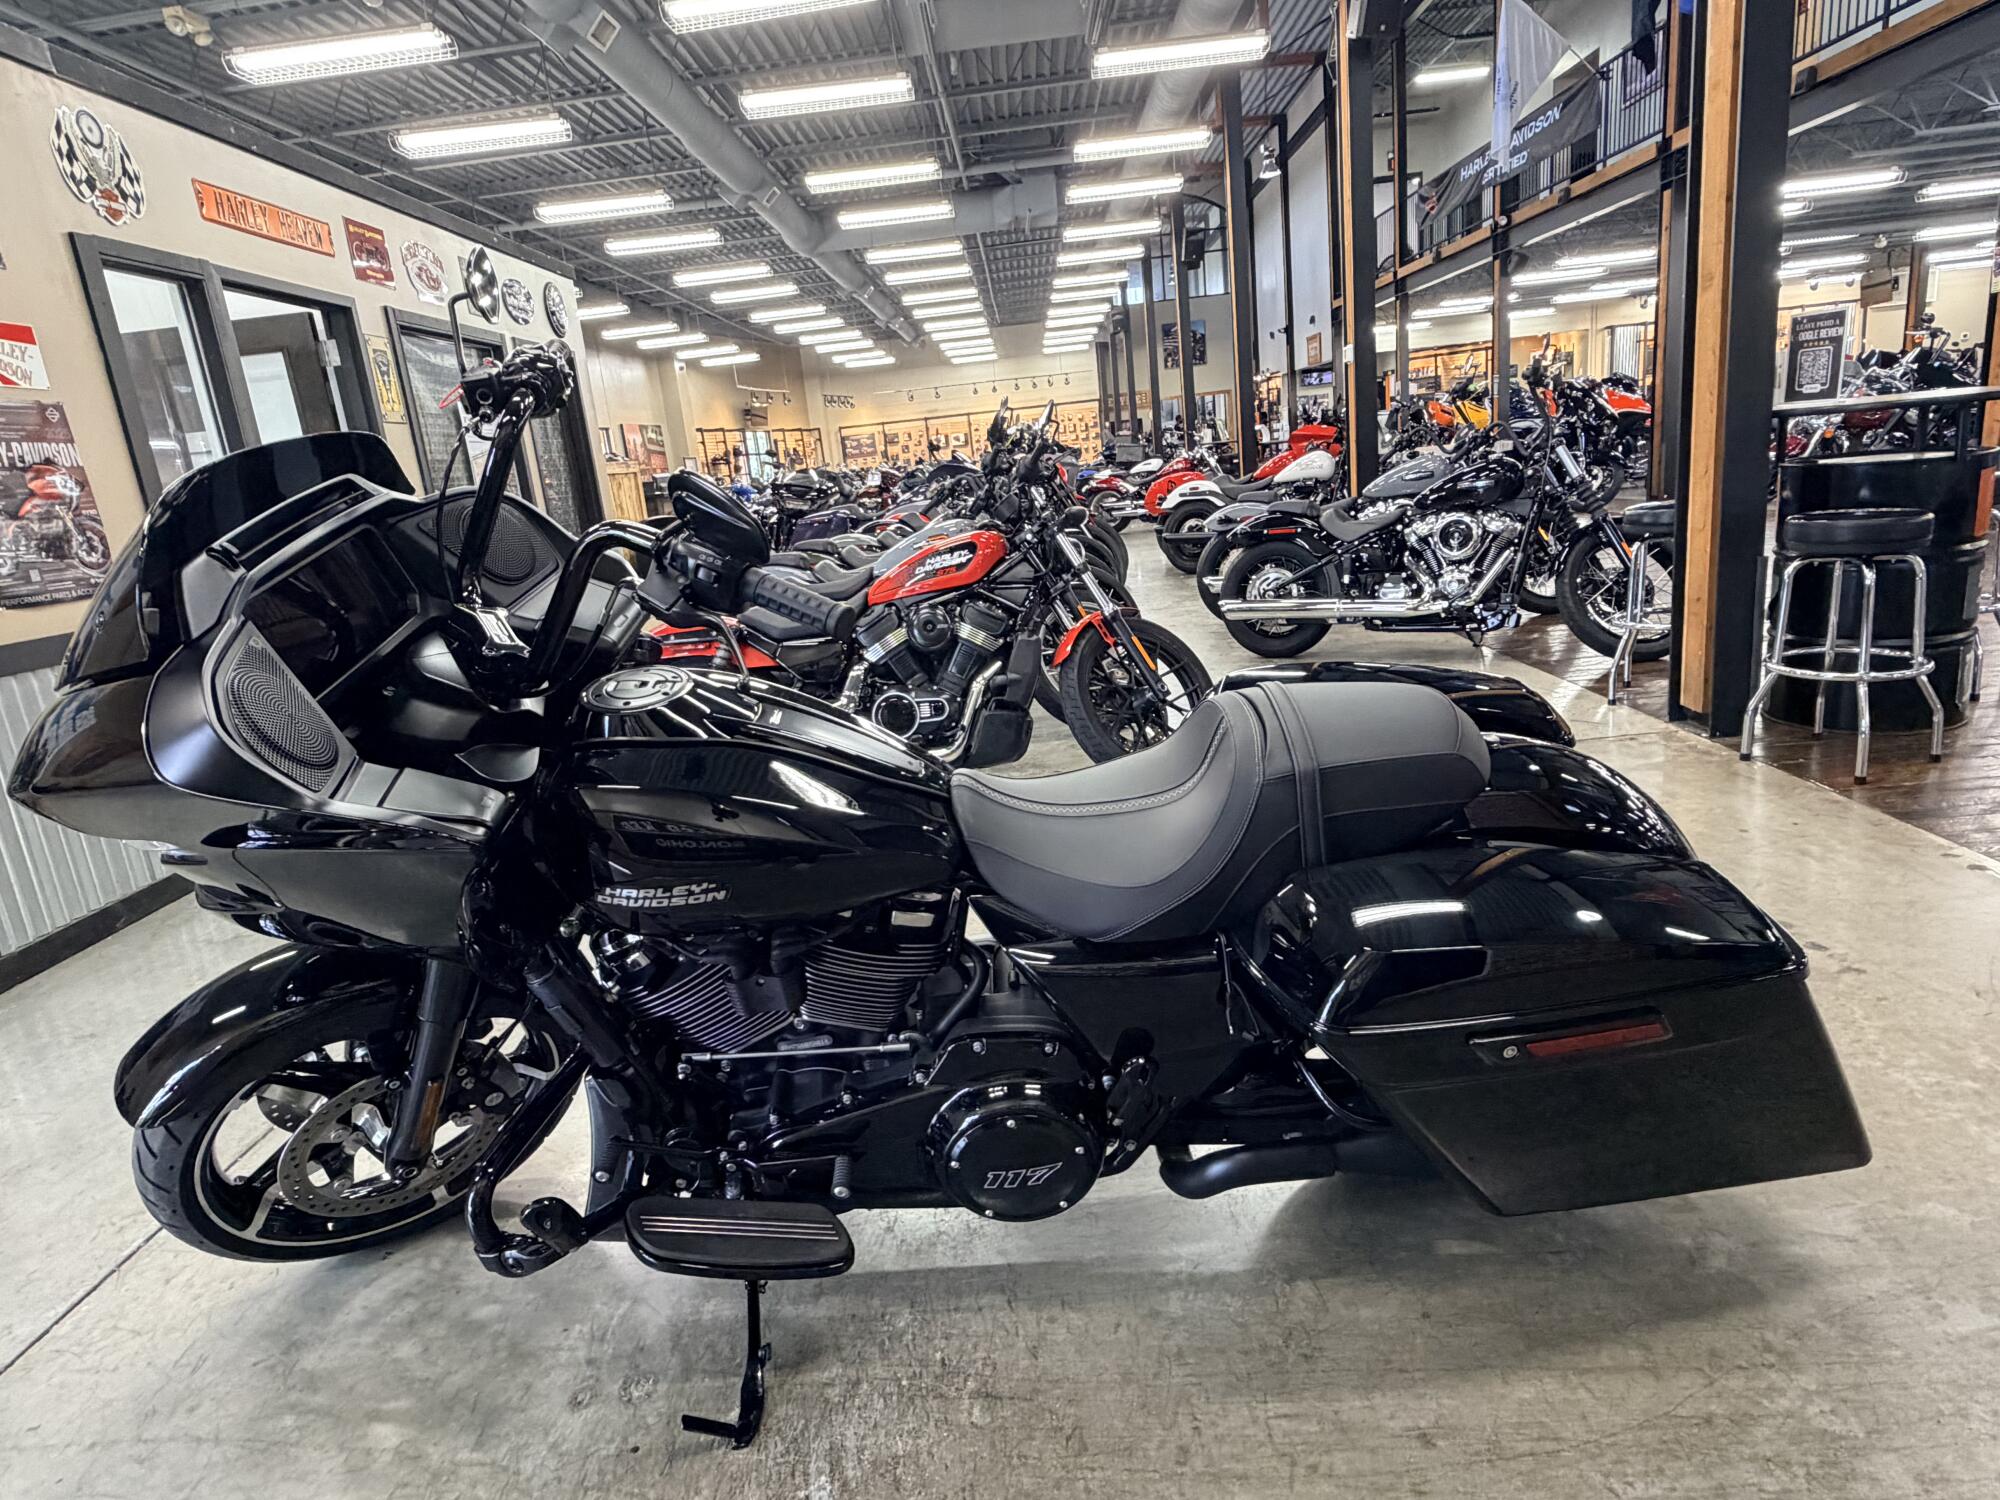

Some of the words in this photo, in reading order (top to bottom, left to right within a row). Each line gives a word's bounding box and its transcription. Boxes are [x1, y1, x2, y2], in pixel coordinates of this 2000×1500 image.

[213, 189, 271, 233] HARLEY
[277, 210, 324, 249] HEAVEN
[1799, 331, 1818, 341] OOGLE
[1820, 327, 1844, 338] REVIEW
[0, 341, 34, 363] LEY-
[0, 441, 82, 468] Y-DAVIDSON
[915, 554, 974, 575] DAVIDSON
[925, 549, 970, 567] HARLEY-
[1, 594, 52, 607] PERFORMANCE
[52, 591, 72, 599] PARTS
[596, 890, 727, 907] DAVIDSON
[605, 882, 717, 898] HARLEY-
[984, 1161, 1064, 1189] 117
